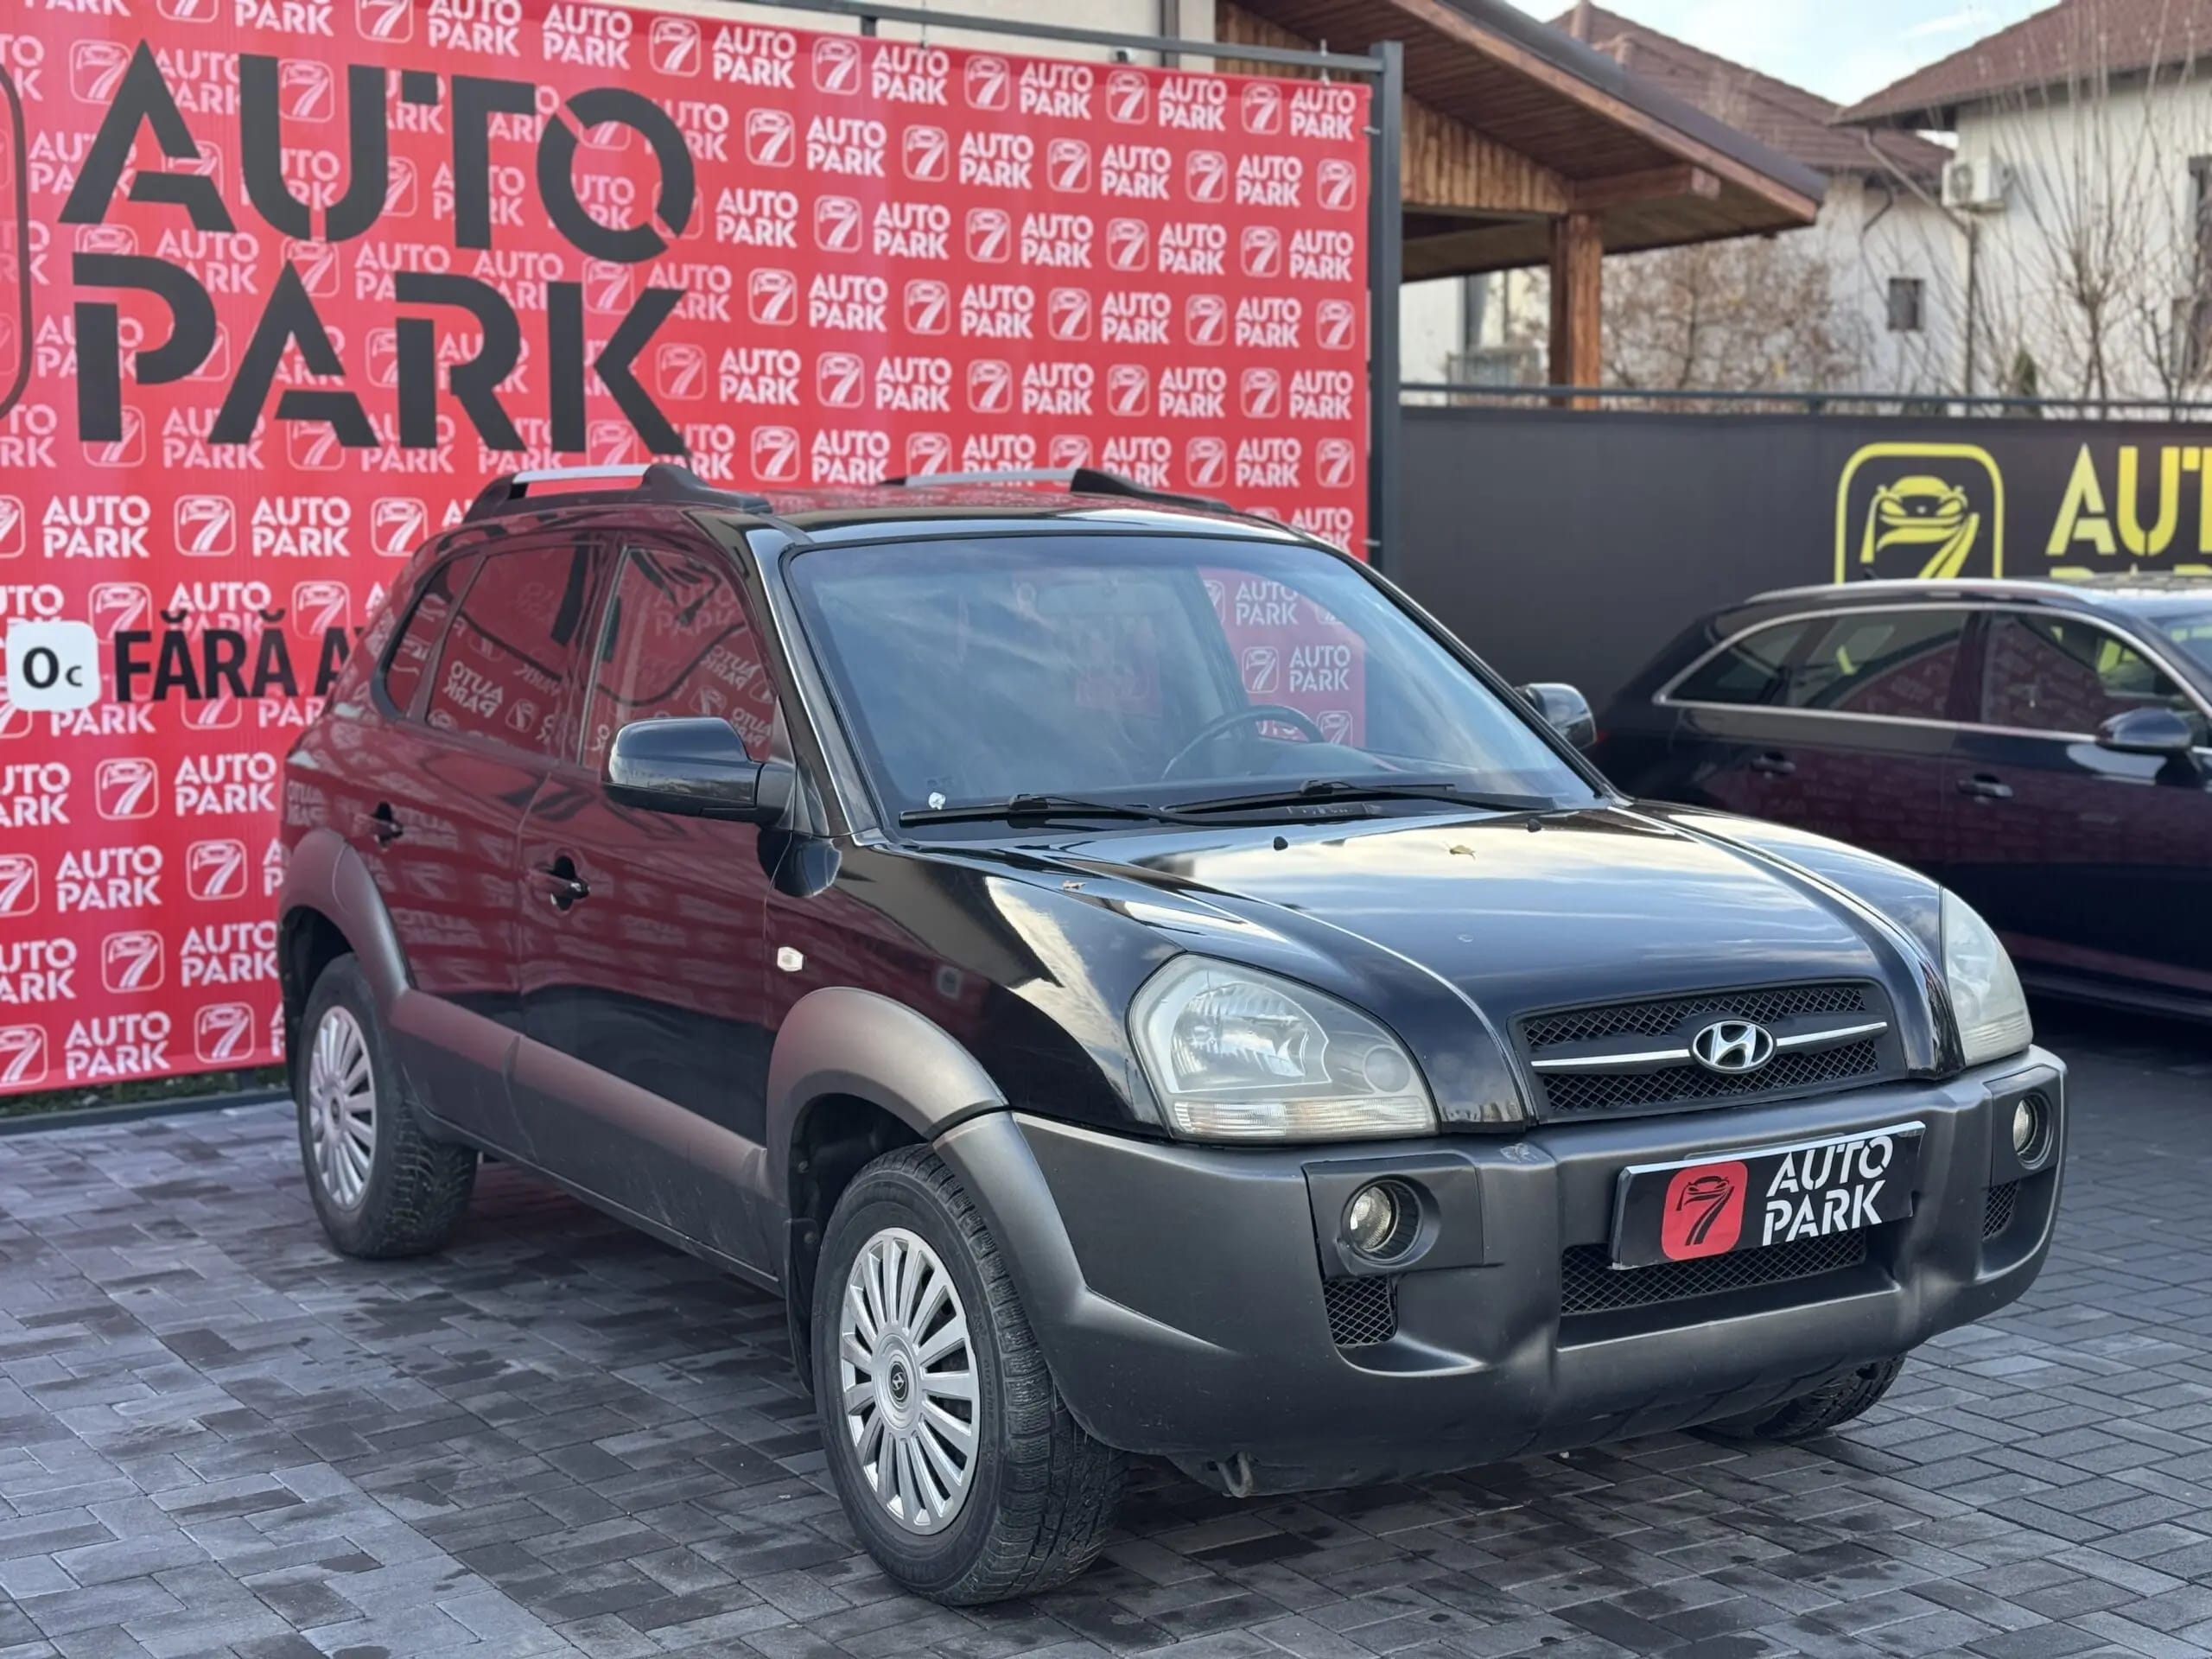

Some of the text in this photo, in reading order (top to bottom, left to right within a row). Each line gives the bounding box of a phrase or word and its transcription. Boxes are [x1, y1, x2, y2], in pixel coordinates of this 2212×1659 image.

[235, 1, 334, 36] PARK
[542, 3, 633, 40] AUTO
[427, 18, 521, 57] PARK
[543, 30, 630, 69] PARK
[713, 26, 797, 59] AUTO
[713, 52, 795, 89] PARK
[871, 45, 949, 76] AUTO
[872, 72, 948, 105] PARK
[1020, 61, 1093, 92] AUTO
[1158, 77, 1227, 106] AUTO
[652, 98, 729, 130] UTO
[1020, 88, 1091, 120] PARK
[1290, 87, 1356, 114] AUTO
[806, 115, 887, 148] AUTO
[1159, 103, 1225, 131] PARK
[1290, 111, 1354, 141] PARK
[29, 130, 137, 164] AU
[58, 39, 695, 262] AUTO
[806, 143, 885, 177] PARK
[959, 131, 1033, 162] AUTO
[1101, 144, 1171, 174] AUTO
[959, 156, 1032, 190] PARK
[1236, 154, 1302, 182] AUTO
[572, 173, 635, 206] UTO
[1102, 170, 1169, 200] PARK
[1236, 181, 1300, 207] PARK
[715, 187, 798, 219] AUTO
[874, 201, 950, 232] AUTO
[716, 214, 797, 248] PARK
[874, 227, 949, 259] PARK
[1020, 213, 1094, 242] AUTO
[1159, 222, 1227, 249] AUTO
[1289, 229, 1354, 257] AUTO
[156, 228, 258, 262] AUTO
[354, 241, 450, 273] AUTO
[1021, 238, 1092, 269] PARK
[474, 250, 563, 282] AUTO
[1159, 247, 1224, 275] PARK
[1290, 254, 1352, 281] PARK
[186, 262, 258, 295] ARK
[645, 263, 732, 292] AUTO
[808, 273, 888, 303] AUTO
[961, 284, 1034, 310] AUTO
[1101, 291, 1172, 317] AUTO
[1236, 297, 1301, 322] AUTO
[809, 302, 887, 332] PARK
[961, 309, 1033, 340] PARK
[1102, 315, 1170, 344] PARK
[1236, 321, 1300, 348] PARK
[72, 253, 688, 454] PARK
[718, 347, 801, 377] AUTO
[875, 357, 951, 385] AUTO
[1021, 363, 1094, 390] AUTO
[1159, 366, 1226, 392] AUTO
[1289, 371, 1353, 396] AUTO
[719, 375, 799, 406] PARK
[876, 383, 950, 412] PARK
[1022, 386, 1092, 416] PARK
[1159, 391, 1225, 417] PARK
[1289, 393, 1351, 420] PARK
[162, 438, 265, 470] PARK
[811, 429, 890, 457] AUTO
[963, 435, 1035, 460] AUTO
[1103, 437, 1172, 462] AUTO
[1236, 438, 1301, 463] AUTO
[361, 445, 454, 474] PARK
[812, 456, 888, 484] PARK
[1236, 461, 1300, 487] PARK
[42, 495, 150, 526] AUTO
[251, 496, 351, 527] AUTO
[1292, 508, 1353, 530] AUTO
[44, 526, 149, 558] PARK
[252, 526, 350, 557] PARK
[168, 582, 271, 613] AUTO
[1236, 602, 1298, 626] PARK
[115, 608, 298, 702] FĂRĂ
[1289, 645, 1351, 668] AUTO
[1290, 669, 1349, 692] PARK
[259, 698, 325, 728] PAR
[175, 752, 276, 785] AUTO
[175, 783, 276, 817] PARK
[55, 845, 163, 880] AUTO
[57, 875, 162, 912] PARK
[181, 920, 276, 956] AUTO
[181, 952, 278, 987] PARK
[65, 1011, 171, 1049] AUTO
[66, 1040, 170, 1080] PARK
[1766, 1135, 1894, 1198] AUTO
[1763, 1179, 1886, 1246] PARK
